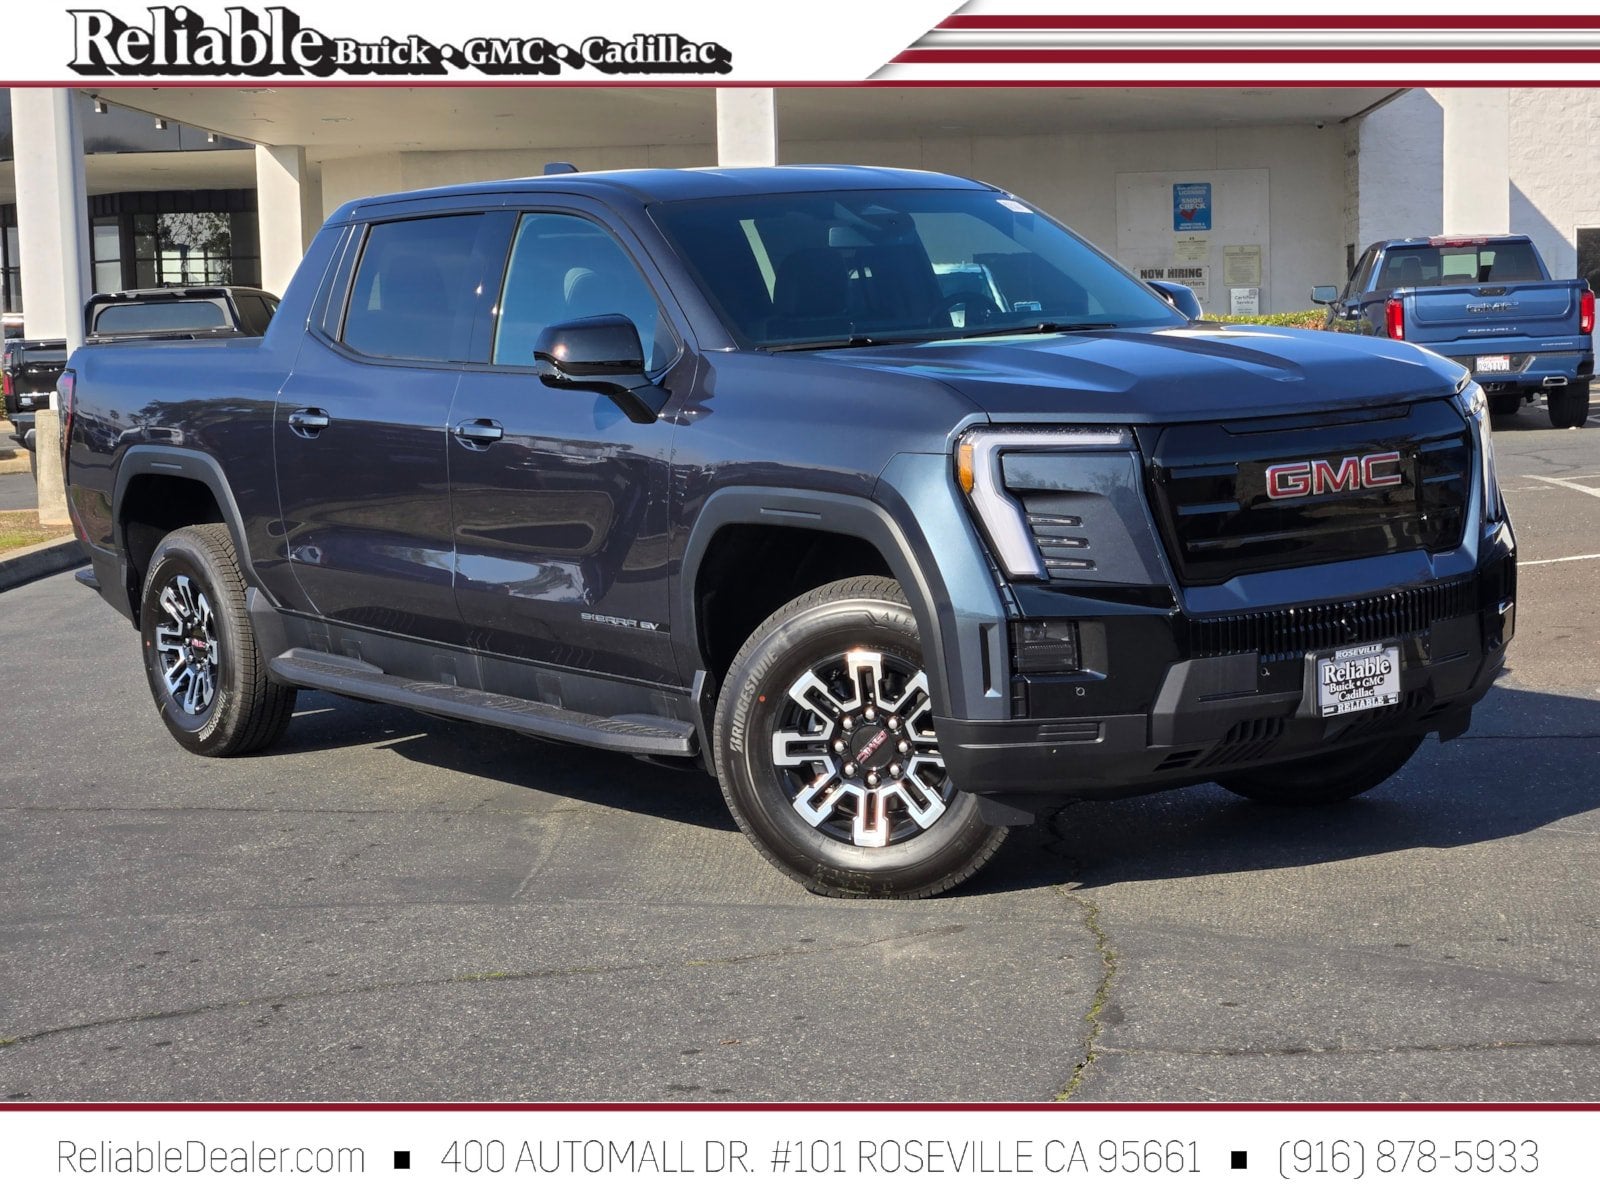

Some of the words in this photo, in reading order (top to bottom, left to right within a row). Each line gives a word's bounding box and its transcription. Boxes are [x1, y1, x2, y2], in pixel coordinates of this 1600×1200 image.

[1140, 269, 1164, 279] NOW
[1167, 268, 1203, 279] HIRING
[1265, 451, 1402, 500] GMC
[580, 612, 639, 627] SIERRA
[639, 621, 660, 630] EV
[1336, 645, 1383, 659] ROSEVILLE
[1324, 656, 1391, 685] Reliable
[1329, 681, 1356, 694] Buick
[1362, 675, 1385, 687] GMC
[729, 651, 778, 754] BRIDGESTONE
[1338, 688, 1375, 702] Cadillac
[1337, 696, 1384, 713] RELIABLE
